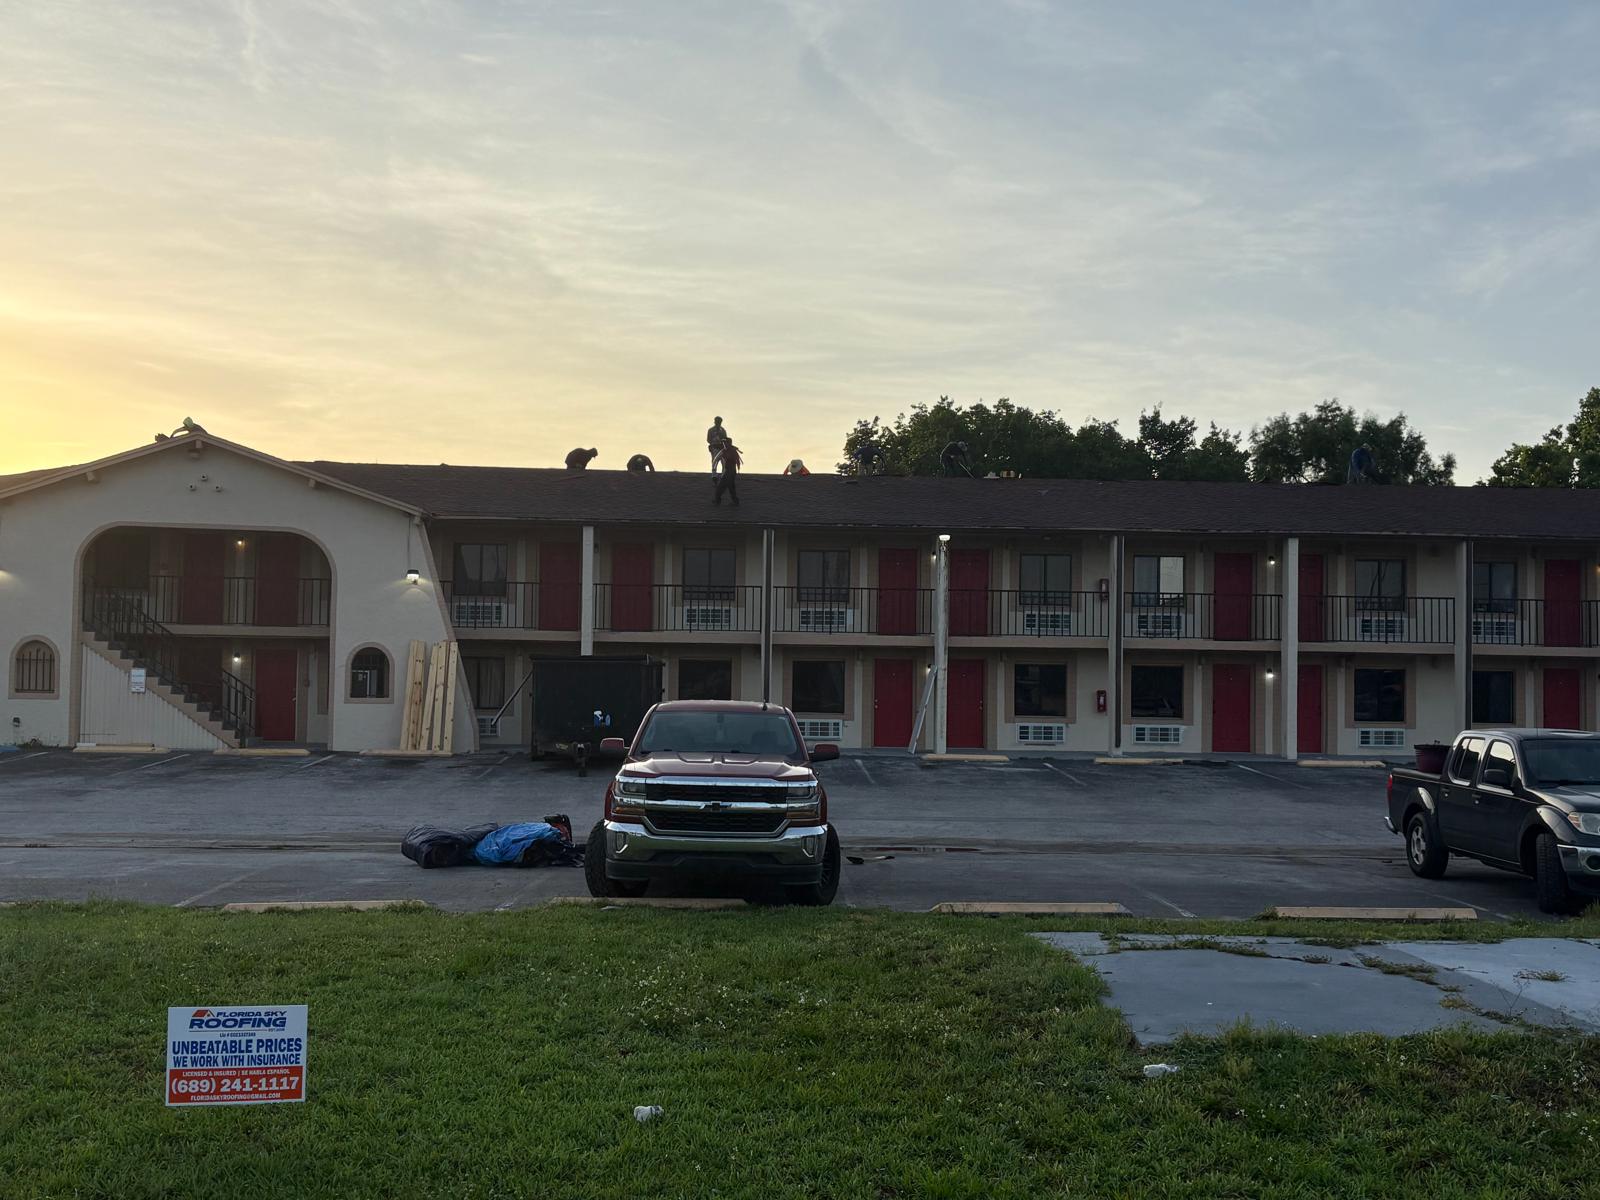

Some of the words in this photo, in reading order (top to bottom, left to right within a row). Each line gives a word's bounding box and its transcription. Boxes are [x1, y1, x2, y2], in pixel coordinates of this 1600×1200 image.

[189, 1017, 287, 1029] ROOFING
[172, 1039, 252, 1055] UNBEATABLE
[256, 1038, 302, 1053] PRICES
[173, 1056, 187, 1067] WE
[190, 1056, 219, 1067] WORK
[221, 1055, 244, 1066] WITH
[247, 1054, 300, 1066] INSURANCE
[172, 1077, 216, 1094] (689)
[220, 1076, 299, 1093] 241-1117
